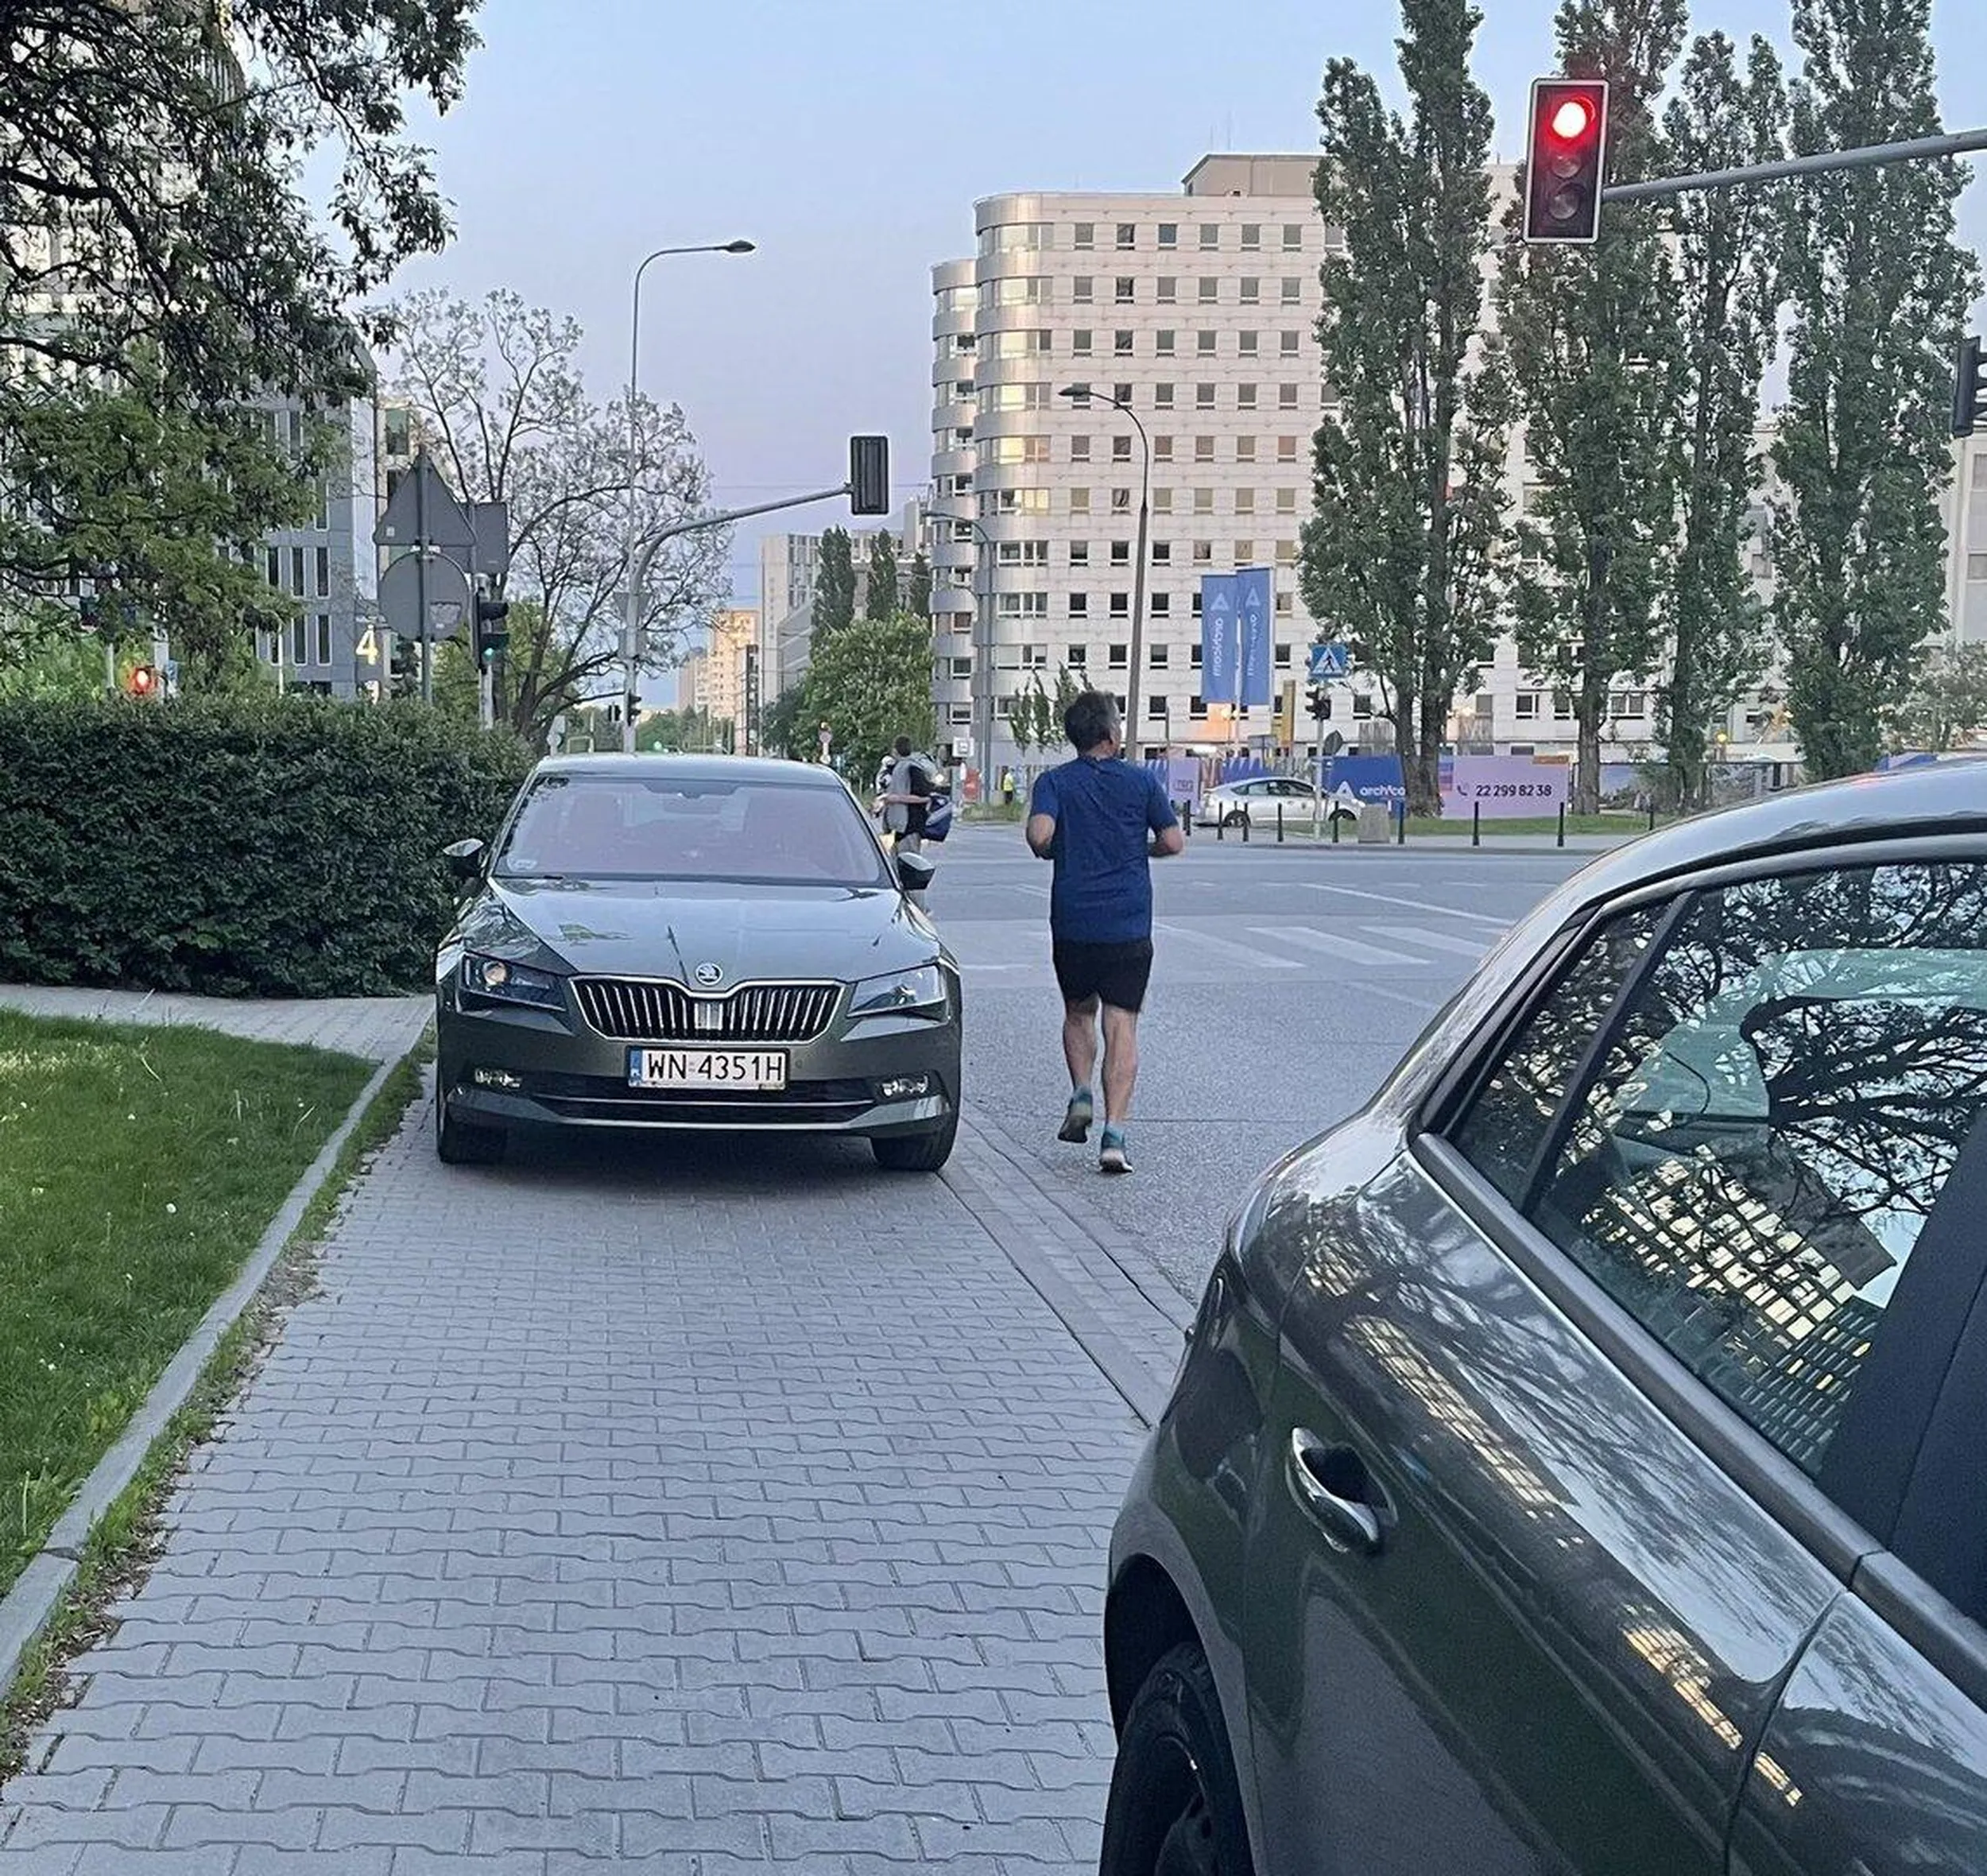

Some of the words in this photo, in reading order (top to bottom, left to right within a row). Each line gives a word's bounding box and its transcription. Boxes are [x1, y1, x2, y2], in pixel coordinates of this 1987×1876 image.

[355, 624, 379, 665] 4
[1359, 785, 1406, 797] archico
[1476, 785, 1491, 797] 22
[1493, 785, 1516, 797] 299
[1519, 785, 1533, 797] 82
[1536, 785, 1552, 797] 38
[648, 1053, 687, 1079] WN
[697, 1055, 782, 1081] 4351H
